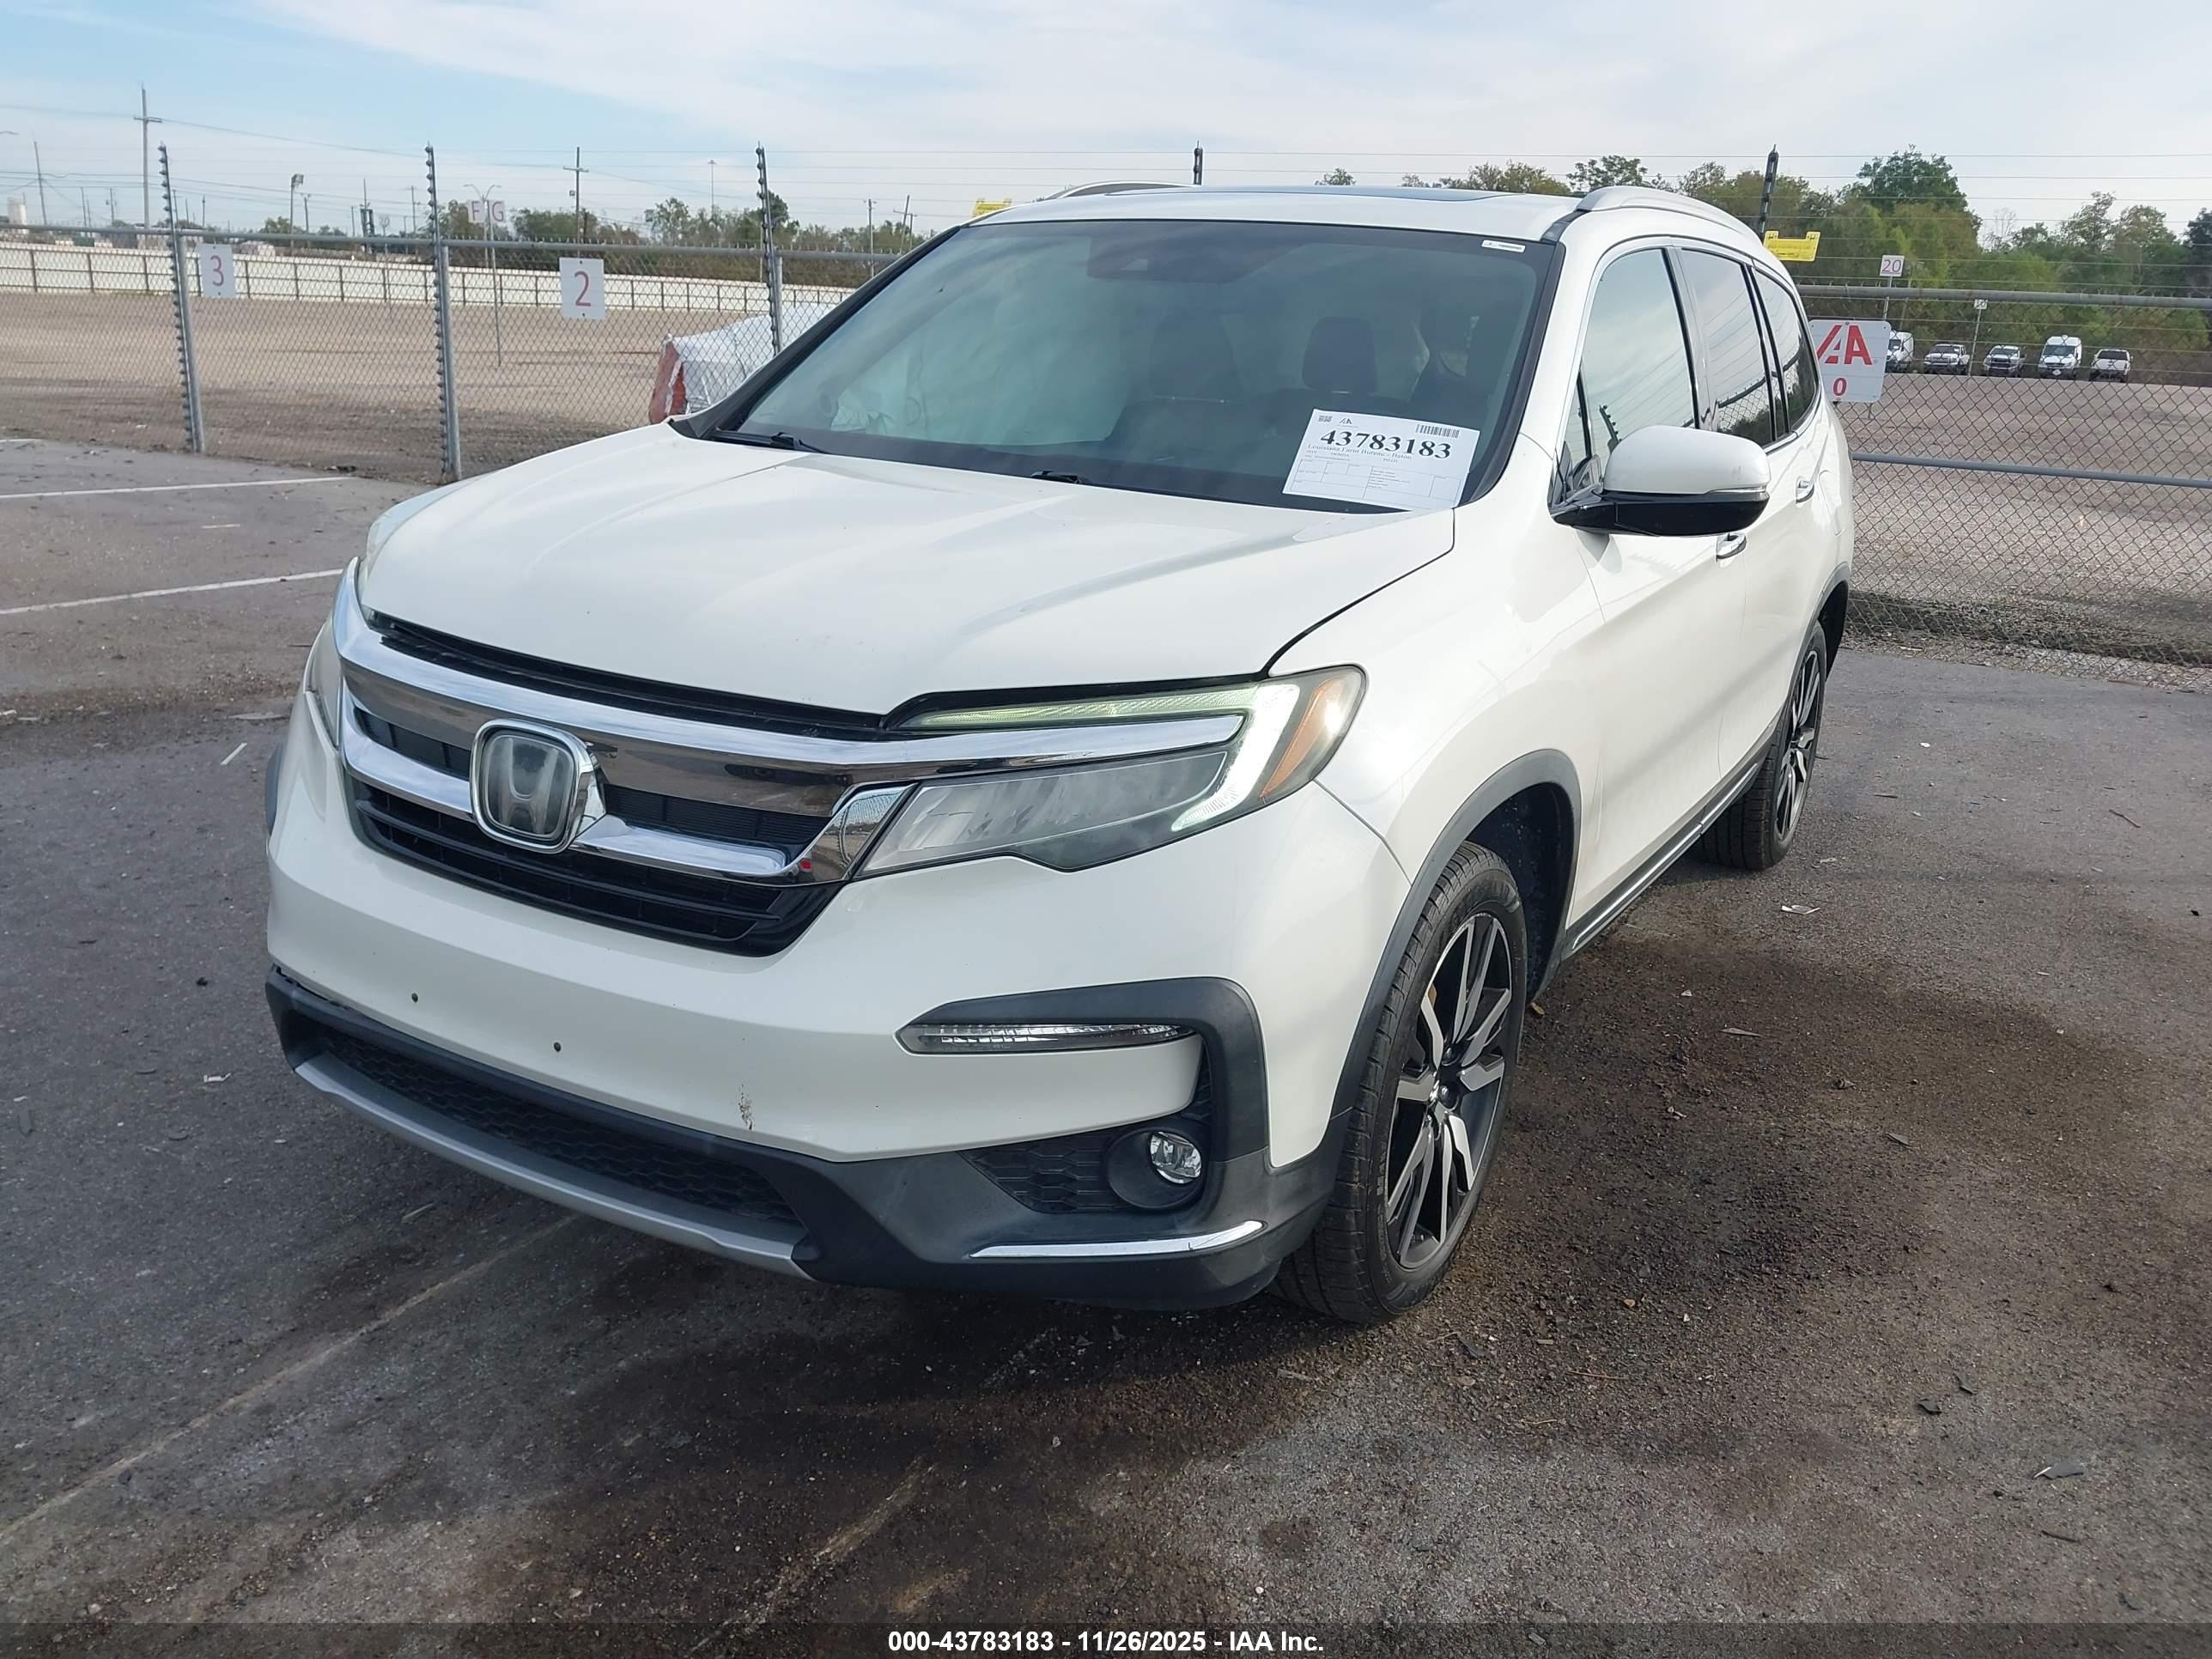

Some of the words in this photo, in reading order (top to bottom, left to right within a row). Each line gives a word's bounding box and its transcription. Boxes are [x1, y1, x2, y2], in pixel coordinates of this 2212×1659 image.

[471, 201, 480, 217] F
[491, 201, 504, 222] G
[210, 255, 224, 287] 3
[1881, 259, 1902, 272] 20
[574, 270, 592, 307] 2
[1321, 429, 1452, 459] 43783183
